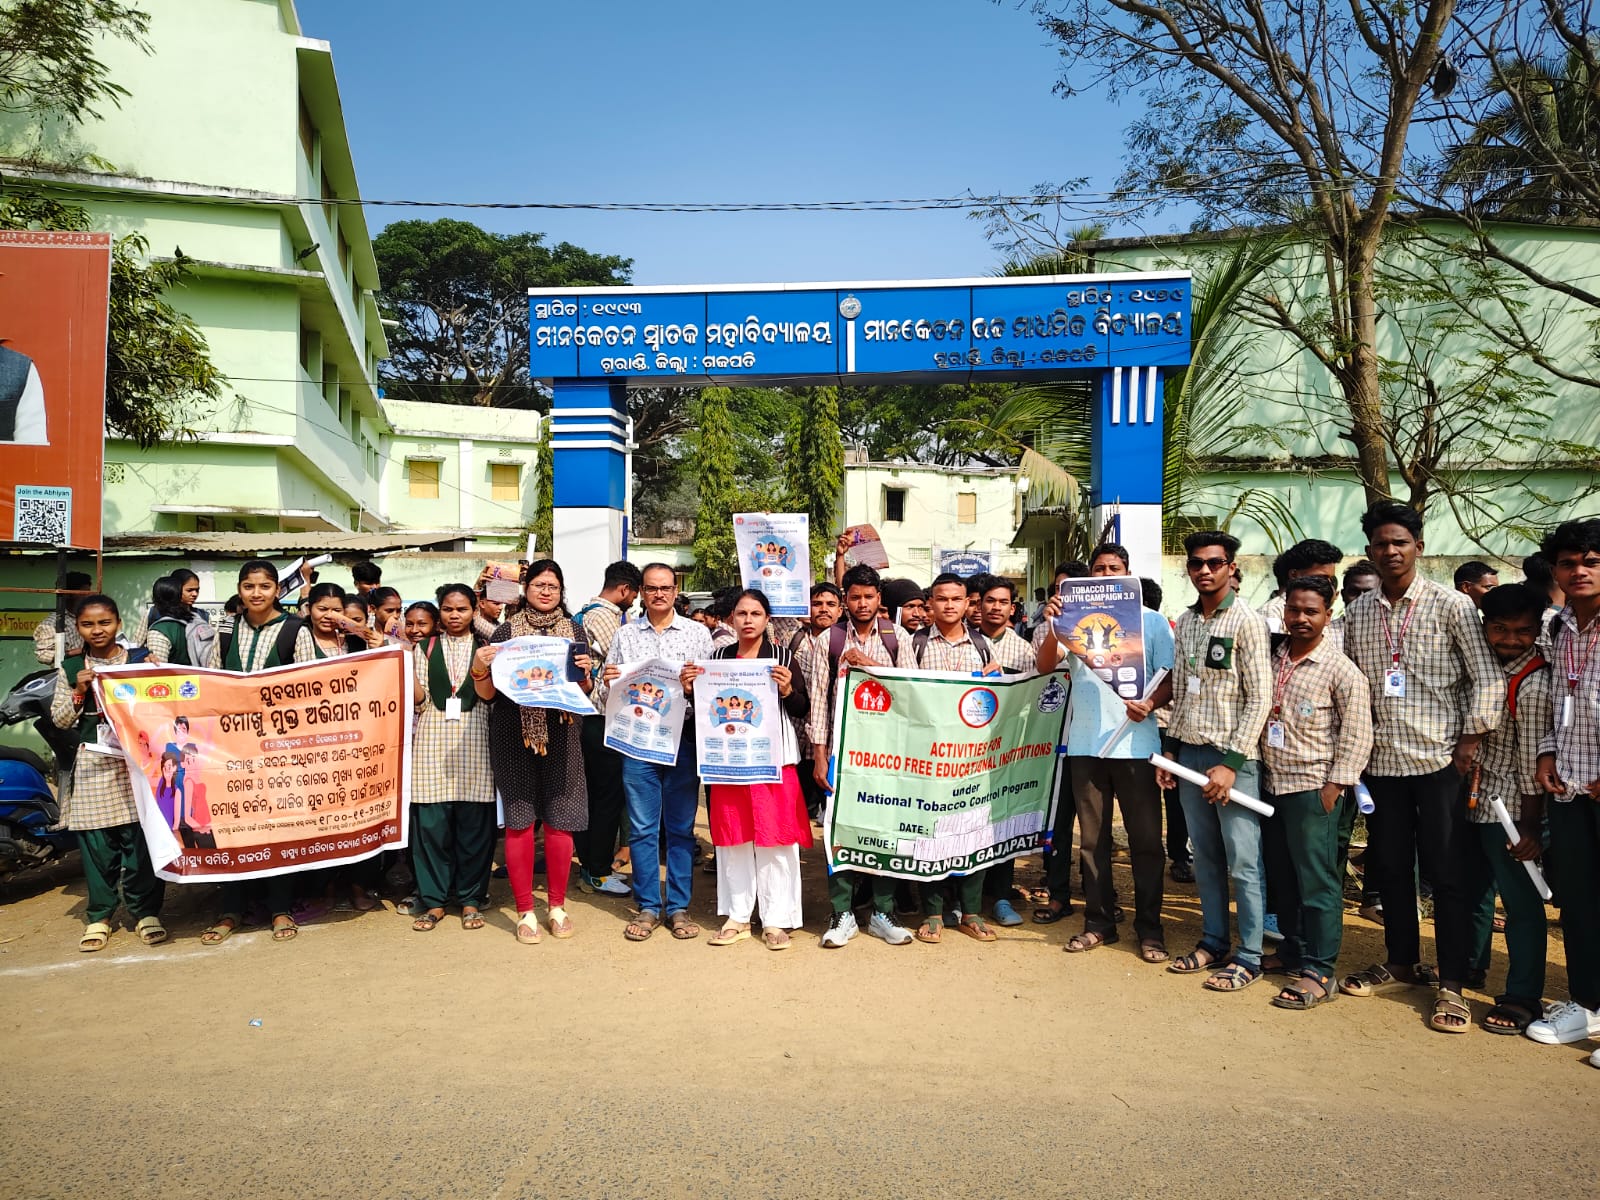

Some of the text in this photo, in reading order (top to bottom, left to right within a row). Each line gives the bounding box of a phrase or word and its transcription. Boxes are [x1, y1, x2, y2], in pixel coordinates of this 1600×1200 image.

[592, 302, 642, 315] ୧୯୯୩
[707, 315, 832, 348] ମହାବିଦ୍ୟାଳୟ
[702, 352, 756, 369] ଗଜପତି
[44, 489, 70, 497] Abhiyan
[1072, 584, 1123, 595] TOBACCO FREE
[1085, 593, 1122, 602] CAMPAIGN
[1124, 592, 1135, 600] 3.0
[260, 669, 358, 707] ଯୁବସମାଜ ପାଇଁ
[219, 710, 264, 737] ତମାଖୁ
[271, 709, 299, 735] ମୁକ୍ତ
[306, 699, 361, 725] ଅଭିଯାନ
[930, 736, 1002, 758] ACTIVITIES FOR
[849, 750, 901, 770] TOBACCO
[904, 757, 933, 776] FREE
[227, 778, 253, 792] ରୋଗ
[296, 772, 328, 787] ରୋଗର
[952, 782, 981, 797] under
[857, 791, 911, 808] National
[916, 798, 966, 812] Tobacco
[969, 789, 1000, 808] Control
[836, 847, 883, 870] CHC,
[889, 854, 973, 874] GURANDI,
